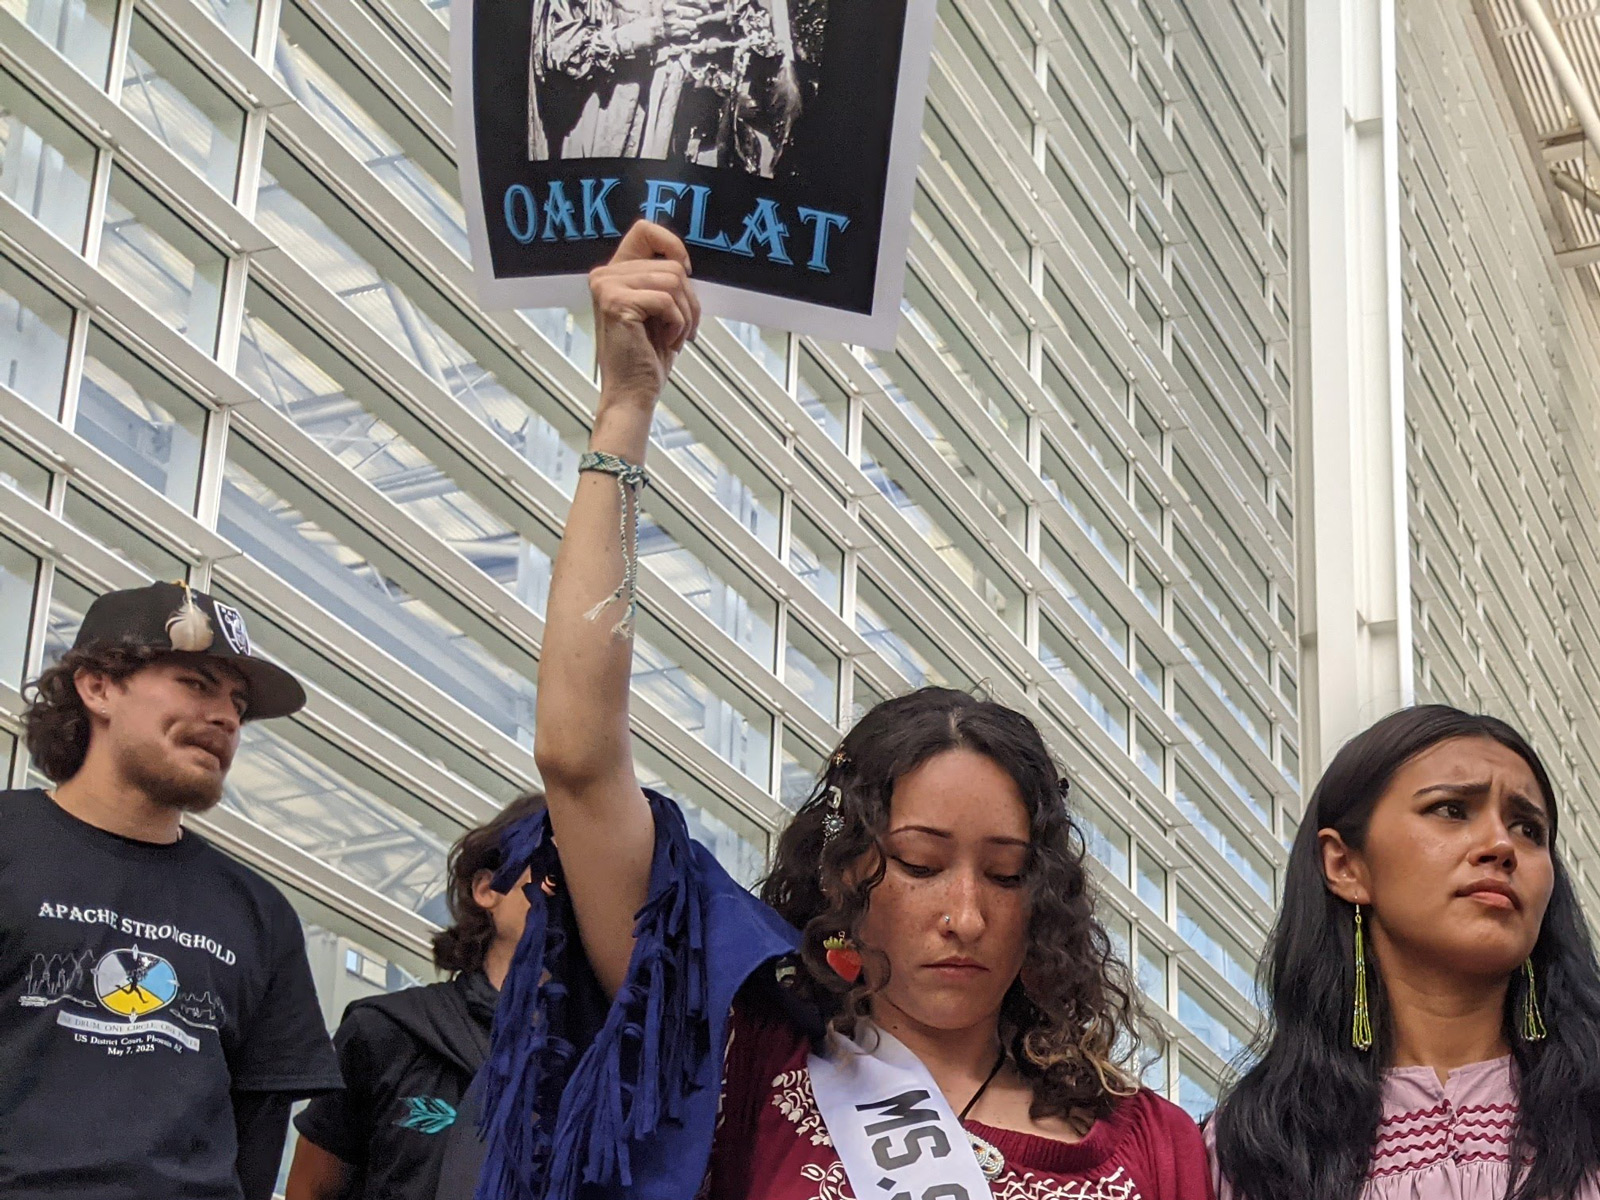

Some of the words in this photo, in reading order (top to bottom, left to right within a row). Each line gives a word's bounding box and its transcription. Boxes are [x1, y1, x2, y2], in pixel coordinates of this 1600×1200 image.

[504, 178, 622, 245] OAK
[639, 179, 850, 273] FLAT
[38, 902, 119, 929] APACHE
[121, 918, 236, 966] STRONGHOLD
[74, 1033, 88, 1043] US
[90, 1036, 118, 1046] District
[107, 1046, 124, 1057] May
[125, 1046, 134, 1055] 7,
[135, 1043, 155, 1053] 2025
